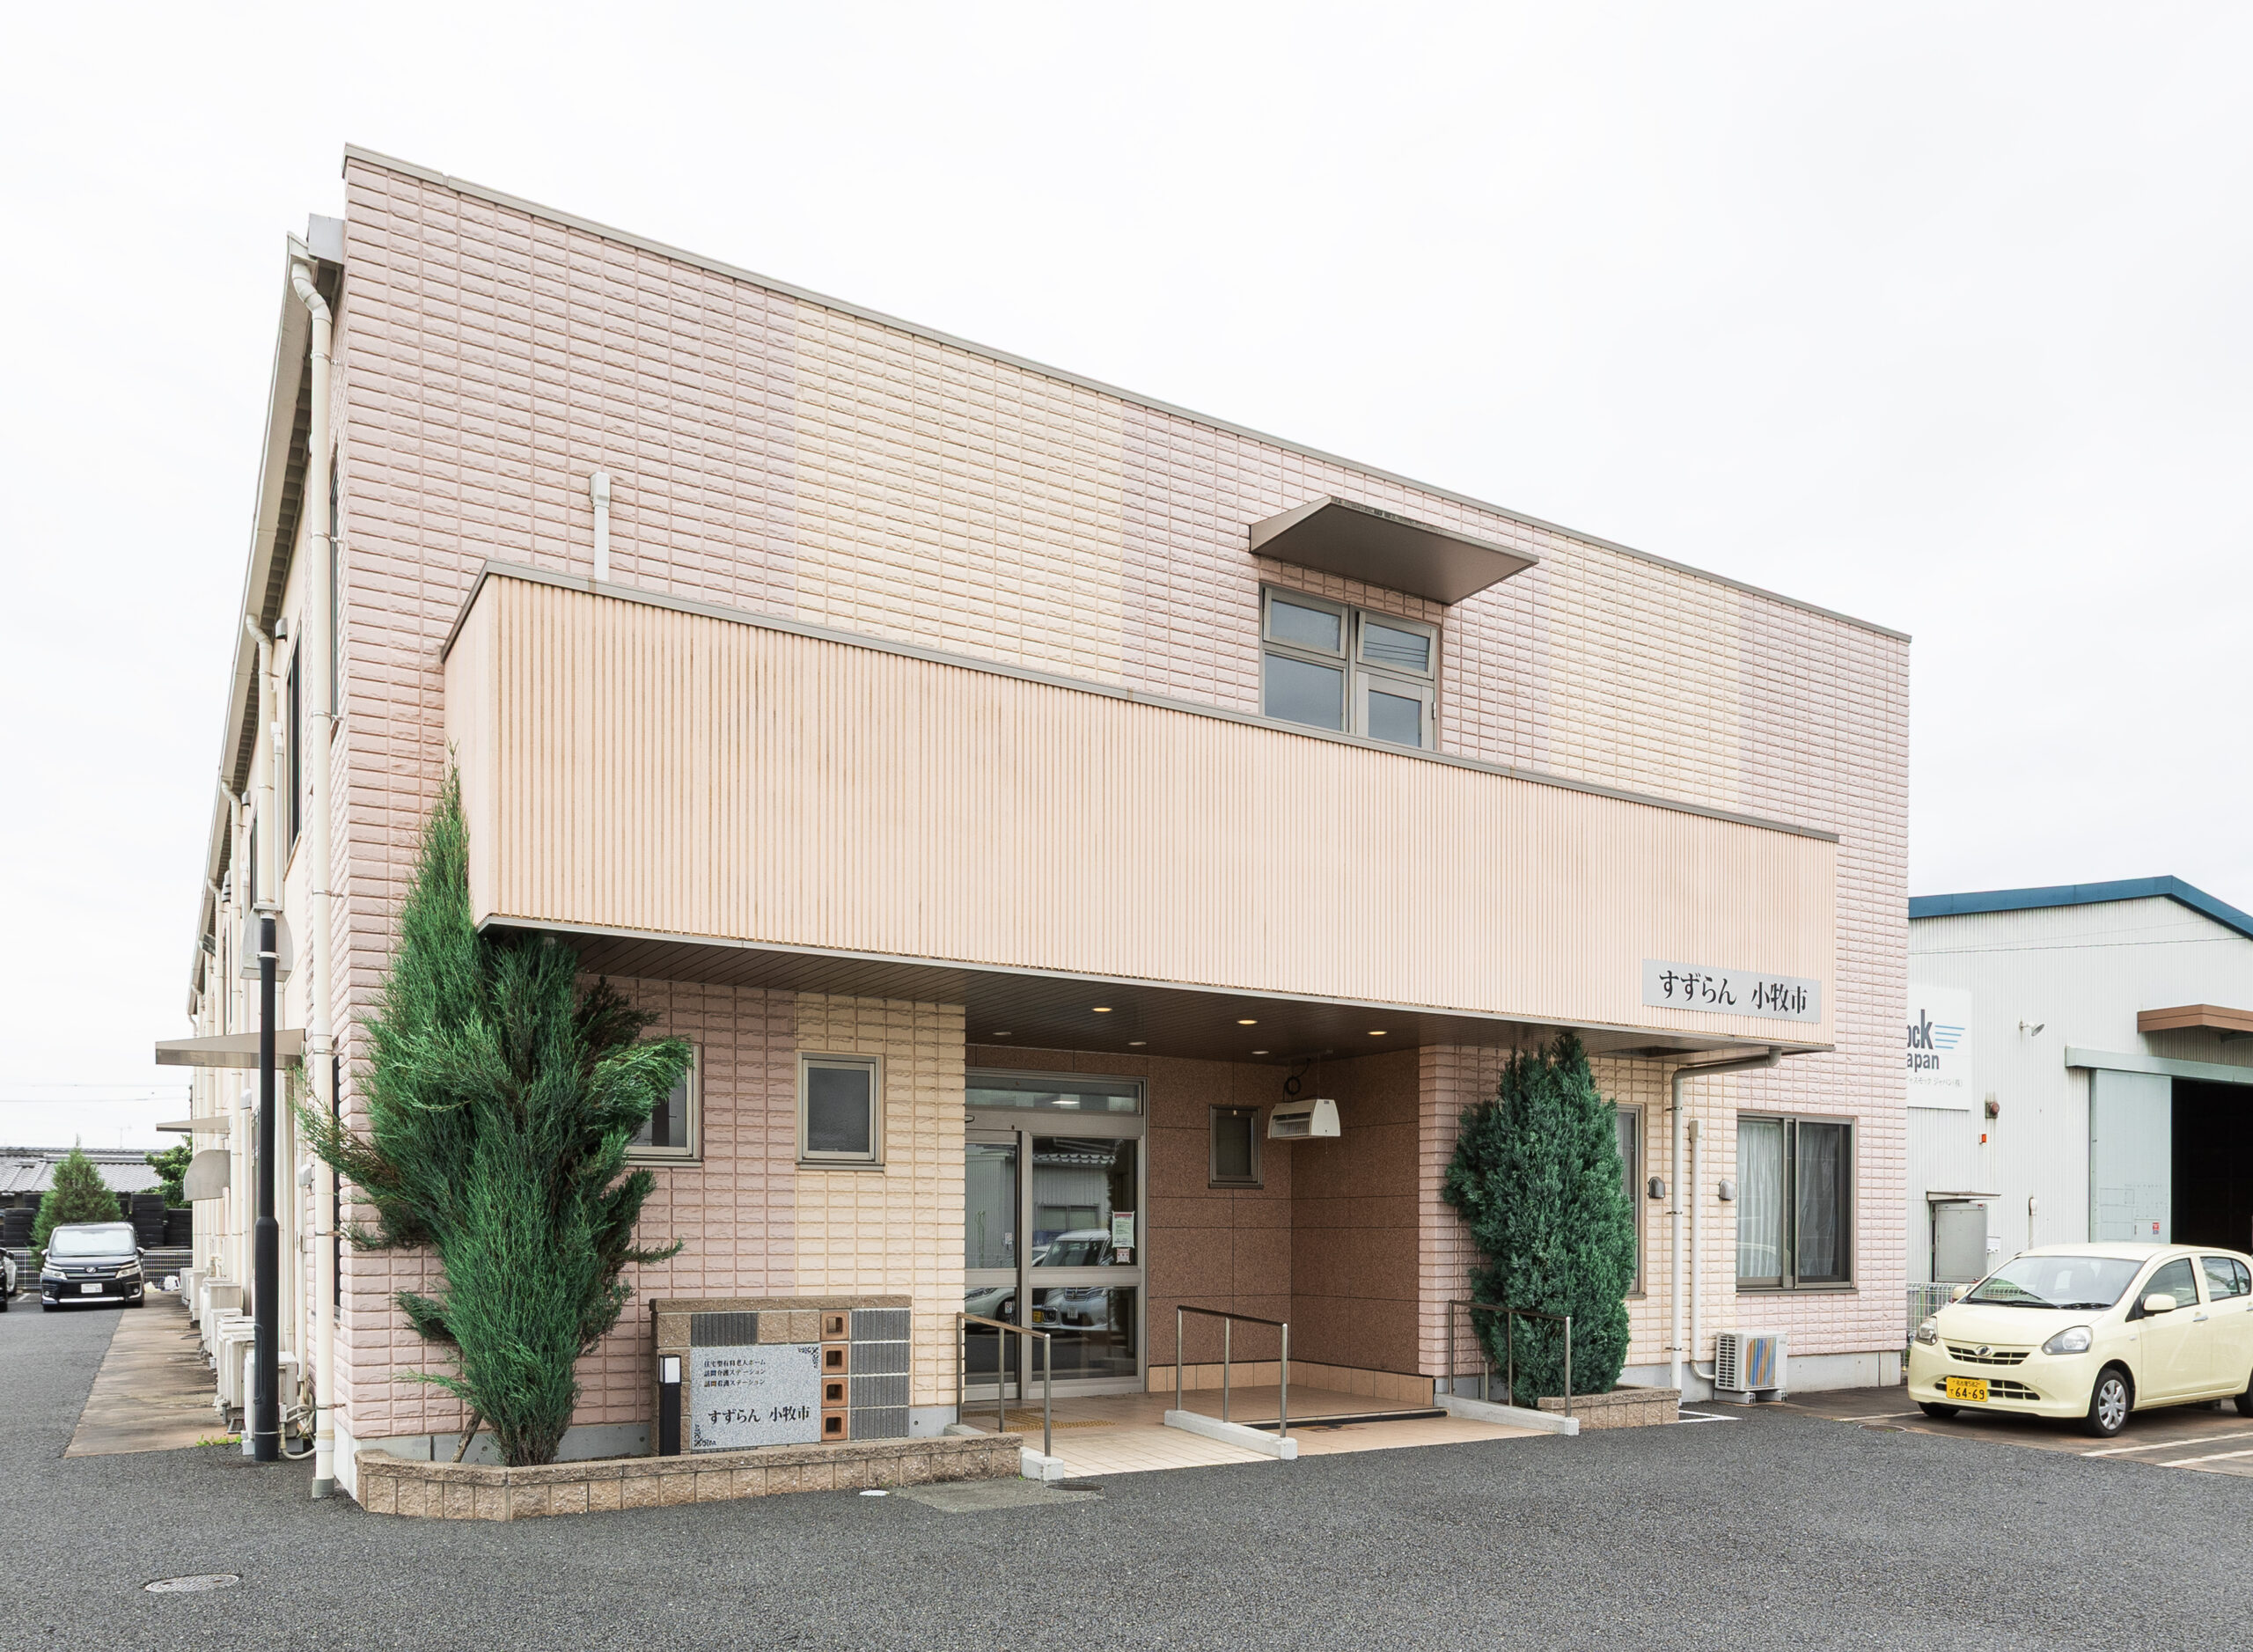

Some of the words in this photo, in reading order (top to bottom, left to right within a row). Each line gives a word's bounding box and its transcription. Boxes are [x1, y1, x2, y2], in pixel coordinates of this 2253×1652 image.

[1659, 970, 1737, 1006] すずらん
[1751, 981, 1808, 1014] 小牧市
[1956, 1387, 1985, 1399] 64-69
[708, 1408, 761, 1424] すずらん
[769, 1406, 810, 1421] 小牧市
